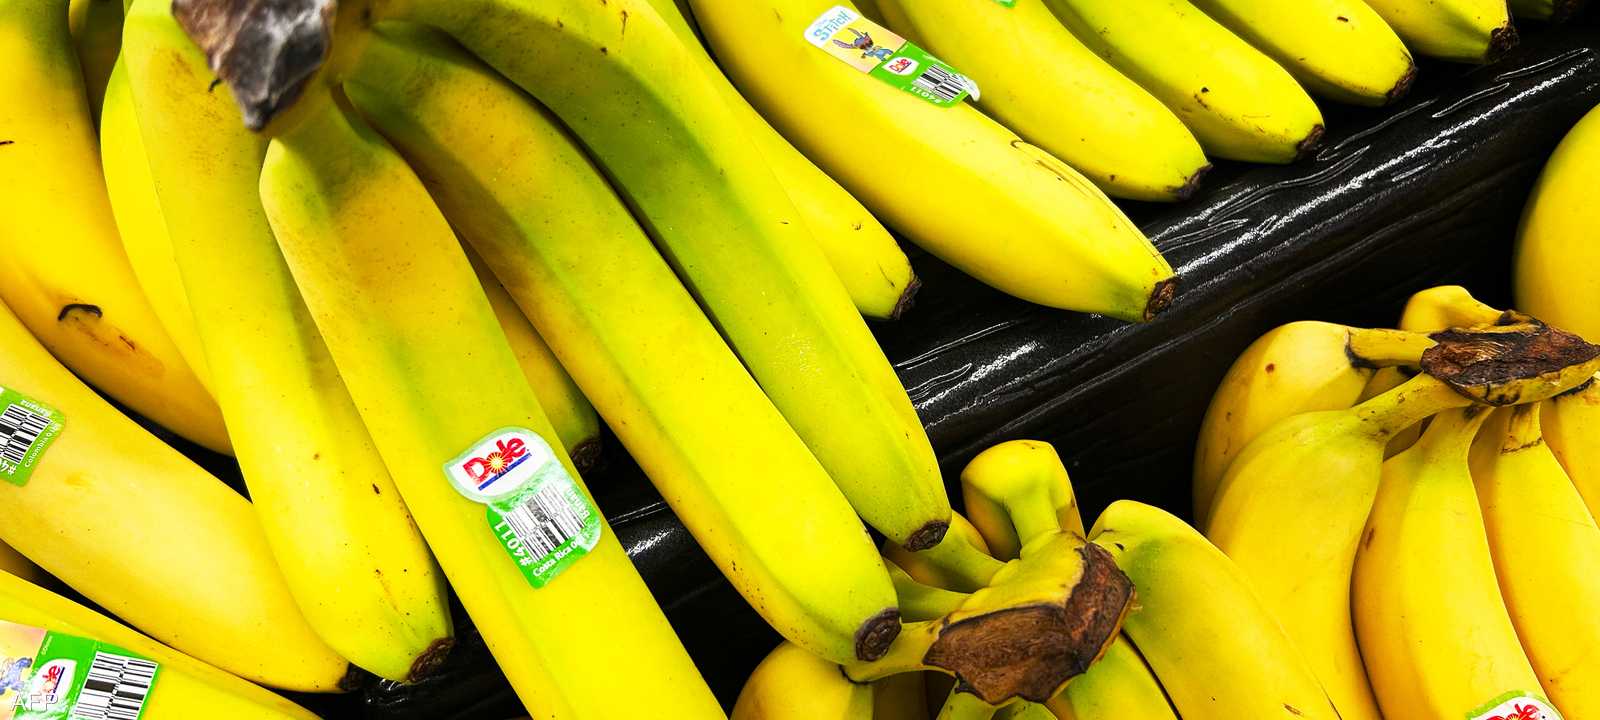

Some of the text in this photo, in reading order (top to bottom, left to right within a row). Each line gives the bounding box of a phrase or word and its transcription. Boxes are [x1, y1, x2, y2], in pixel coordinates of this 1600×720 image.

[889, 58, 912, 73] Dole
[0, 460, 17, 476] #4
[25, 437, 48, 468] Colombia
[463, 437, 527, 486] Dole
[495, 519, 533, 567] #4011
[533, 545, 572, 577] Costa Rica
